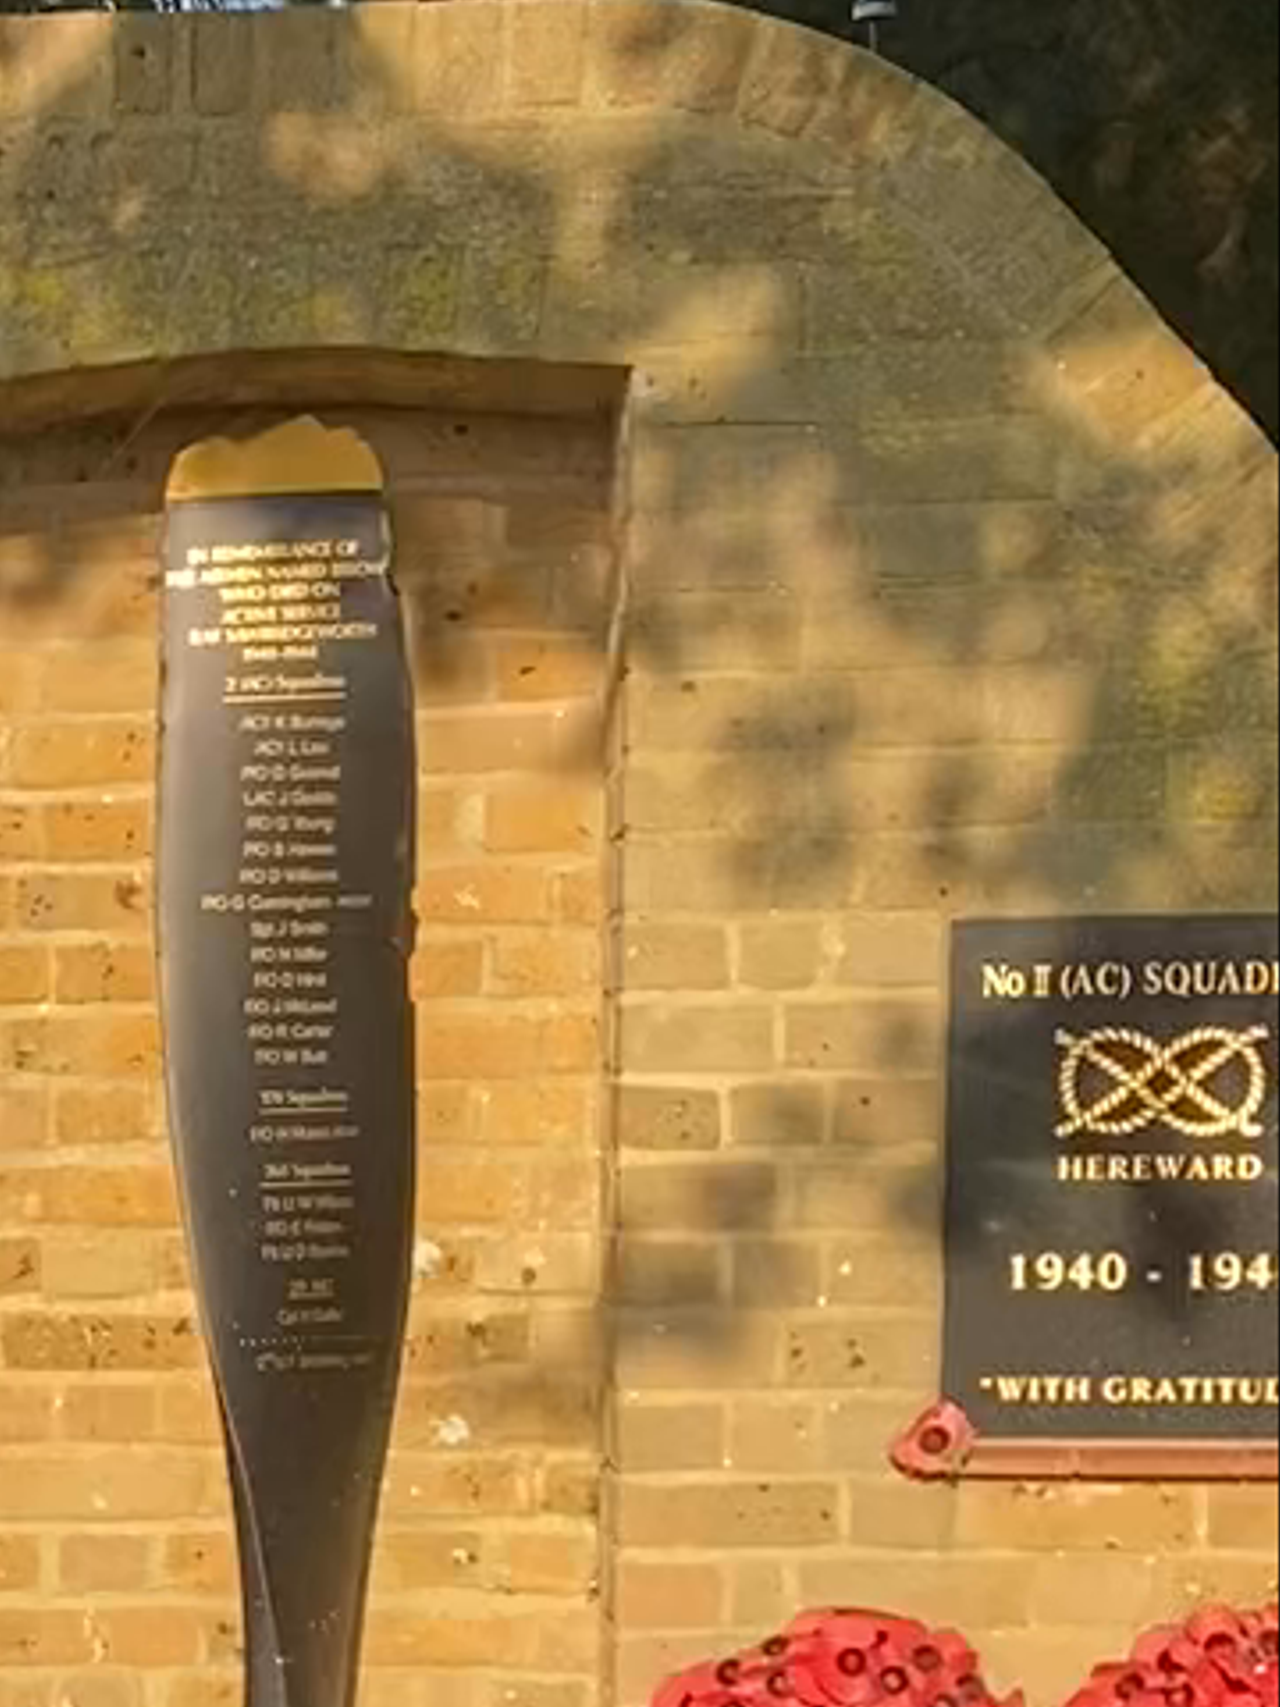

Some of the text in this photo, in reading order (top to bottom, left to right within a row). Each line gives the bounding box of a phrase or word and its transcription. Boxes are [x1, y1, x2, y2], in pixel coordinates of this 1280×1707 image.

[1059, 961, 1133, 999] (AC)
[1142, 960, 1278, 998] SQUAD
[1056, 1153, 1265, 1182] HEREWARD
[1009, 1252, 1128, 1291] 1940
